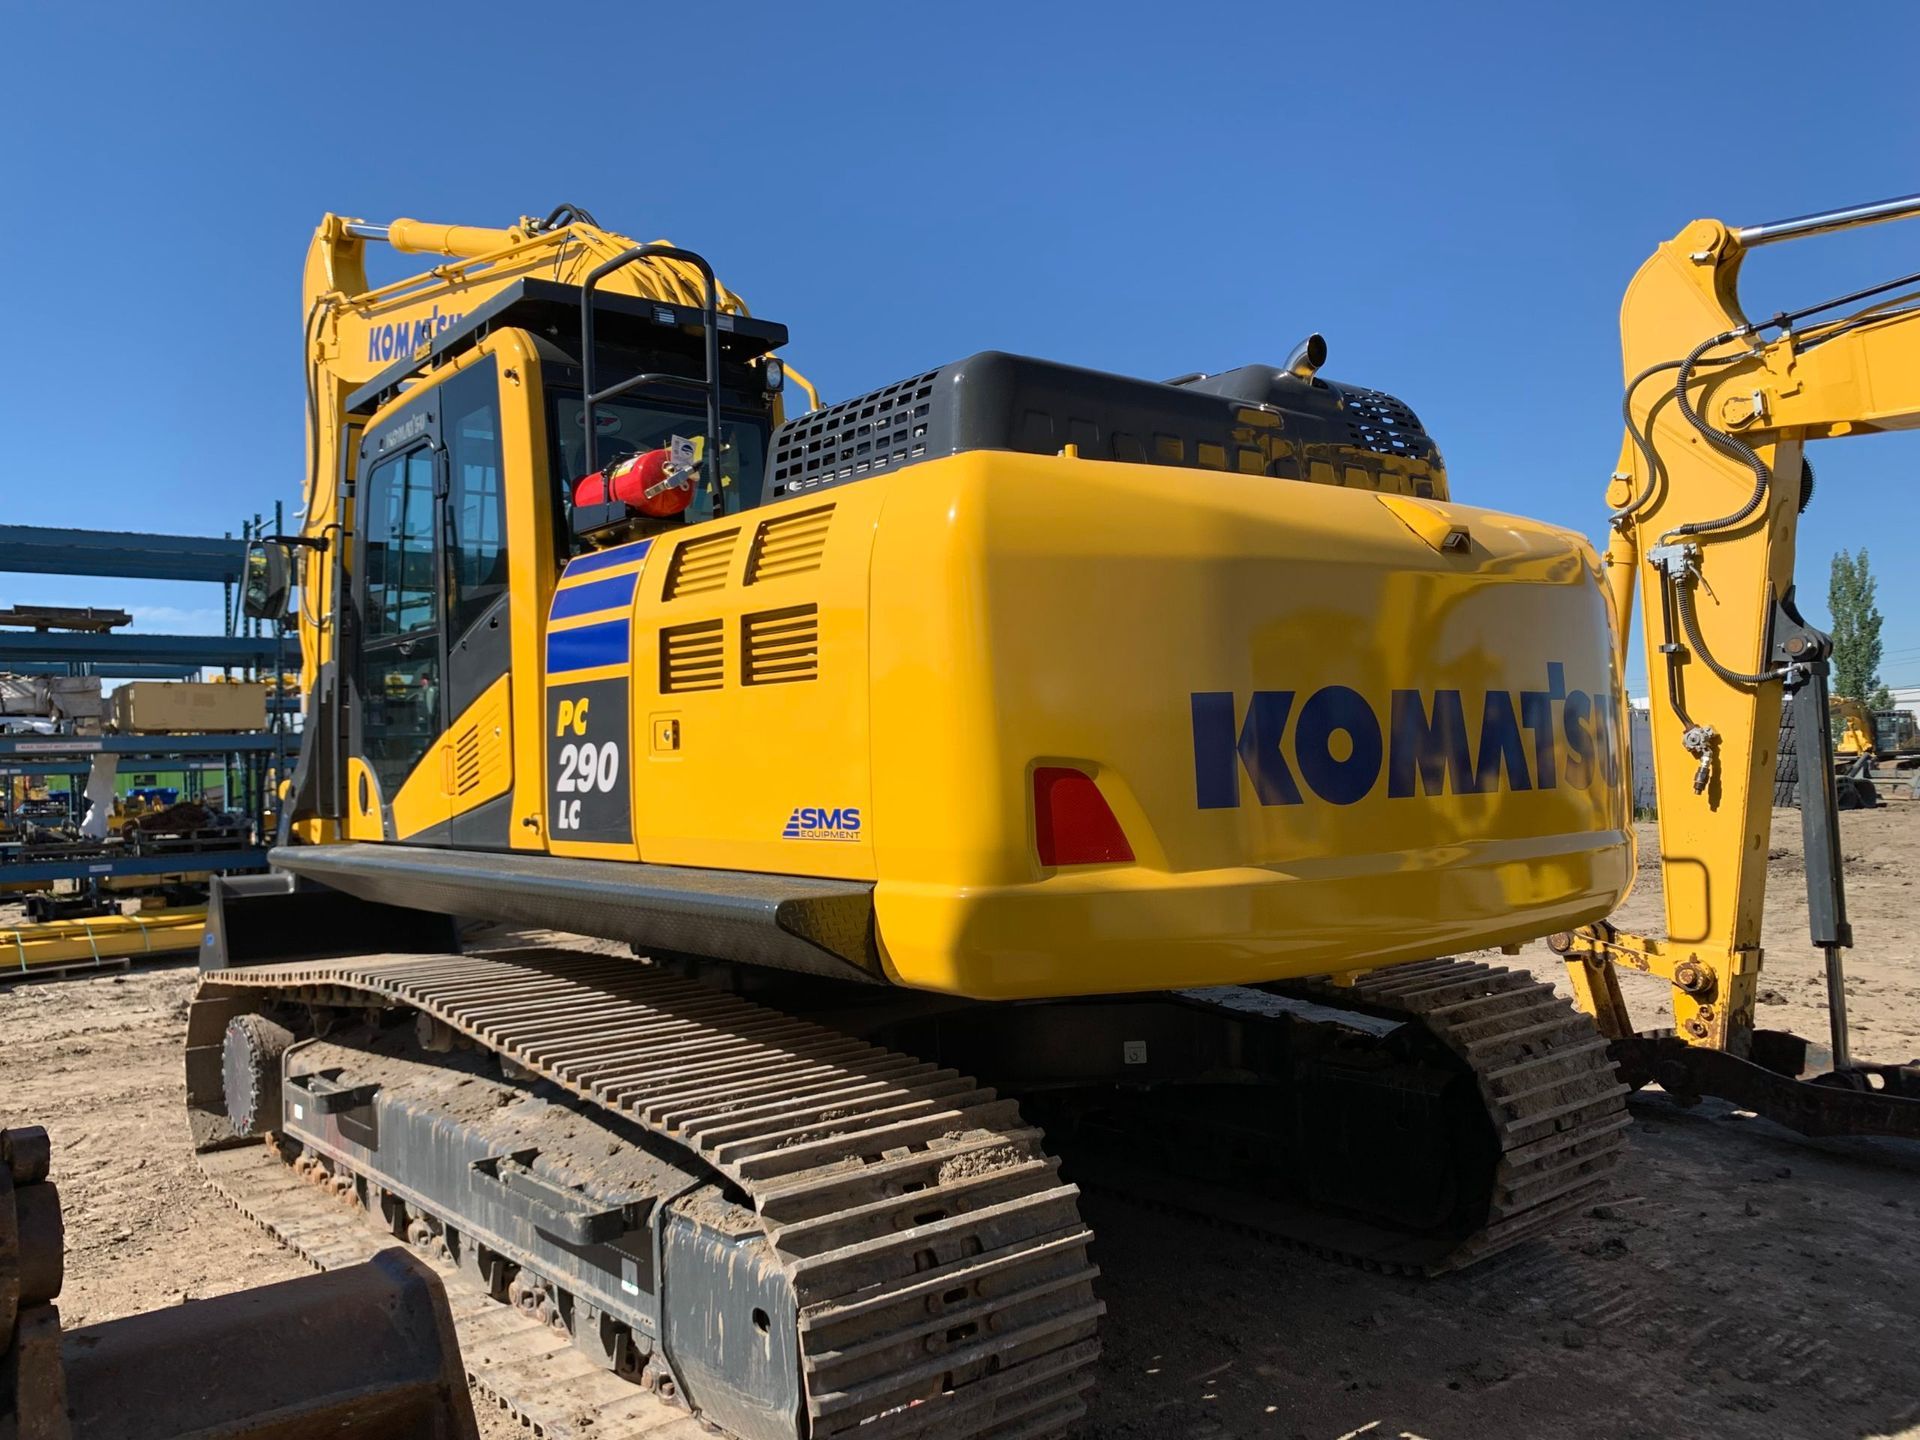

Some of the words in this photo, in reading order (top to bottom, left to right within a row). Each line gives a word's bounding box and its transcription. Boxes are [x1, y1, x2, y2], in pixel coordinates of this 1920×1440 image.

[556, 697, 589, 737] PC
[1191, 661, 1618, 809] KOMATSU
[556, 741, 619, 793] 290
[558, 799, 581, 830] LC
[800, 808, 861, 830] SMS
[800, 830, 861, 839] EQUIPMENT
